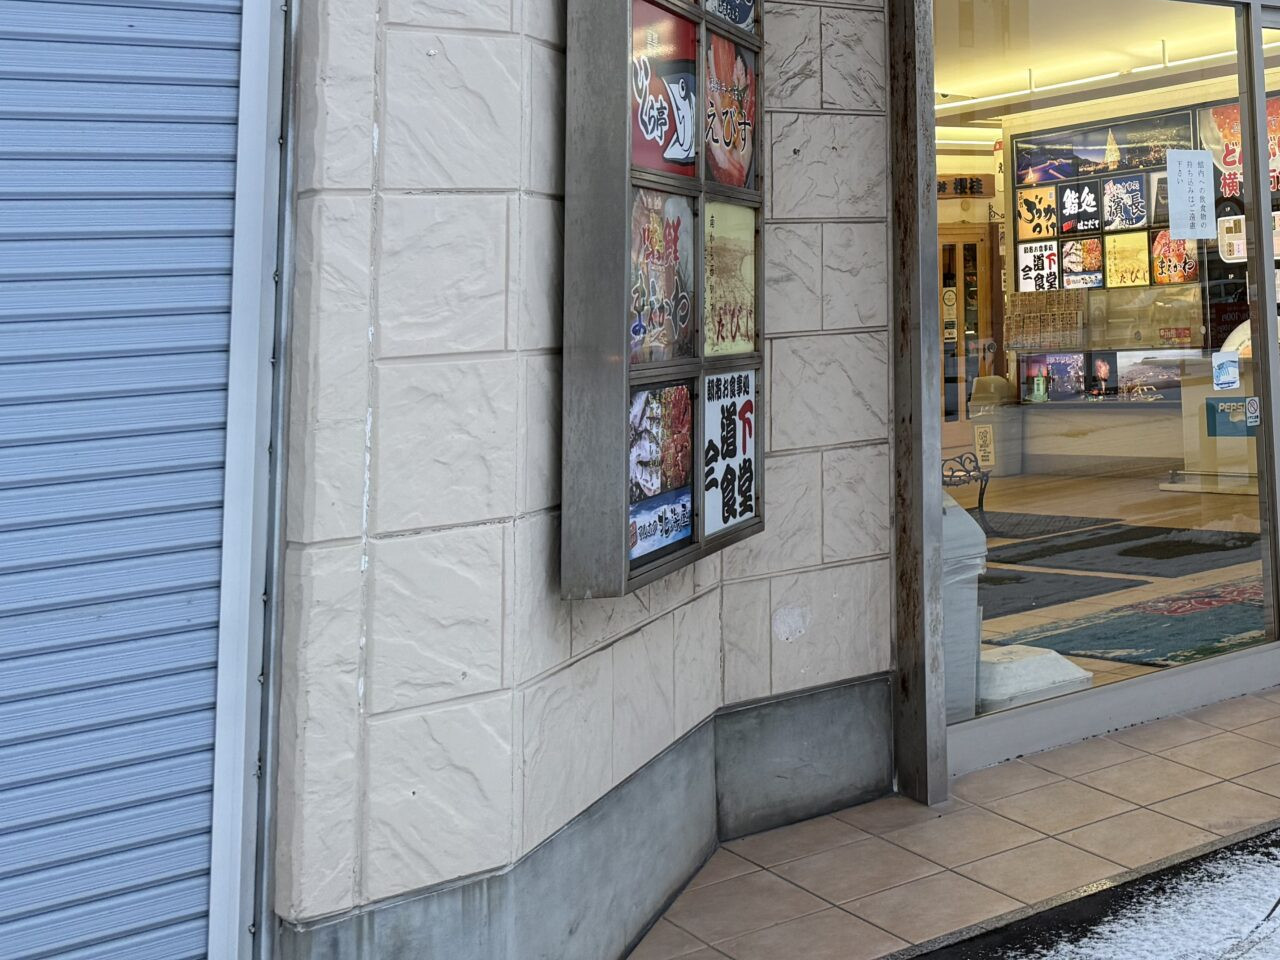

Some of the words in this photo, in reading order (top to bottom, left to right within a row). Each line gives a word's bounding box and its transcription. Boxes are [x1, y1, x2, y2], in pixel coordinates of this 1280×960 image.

[705, 100, 752, 152] えびす
[1062, 186, 1098, 216] 鮨処
[1107, 192, 1146, 220] 濱長
[1078, 220, 1100, 230] はこだて
[1034, 272, 1058, 291] 食堂
[720, 458, 754, 524] 食堂
